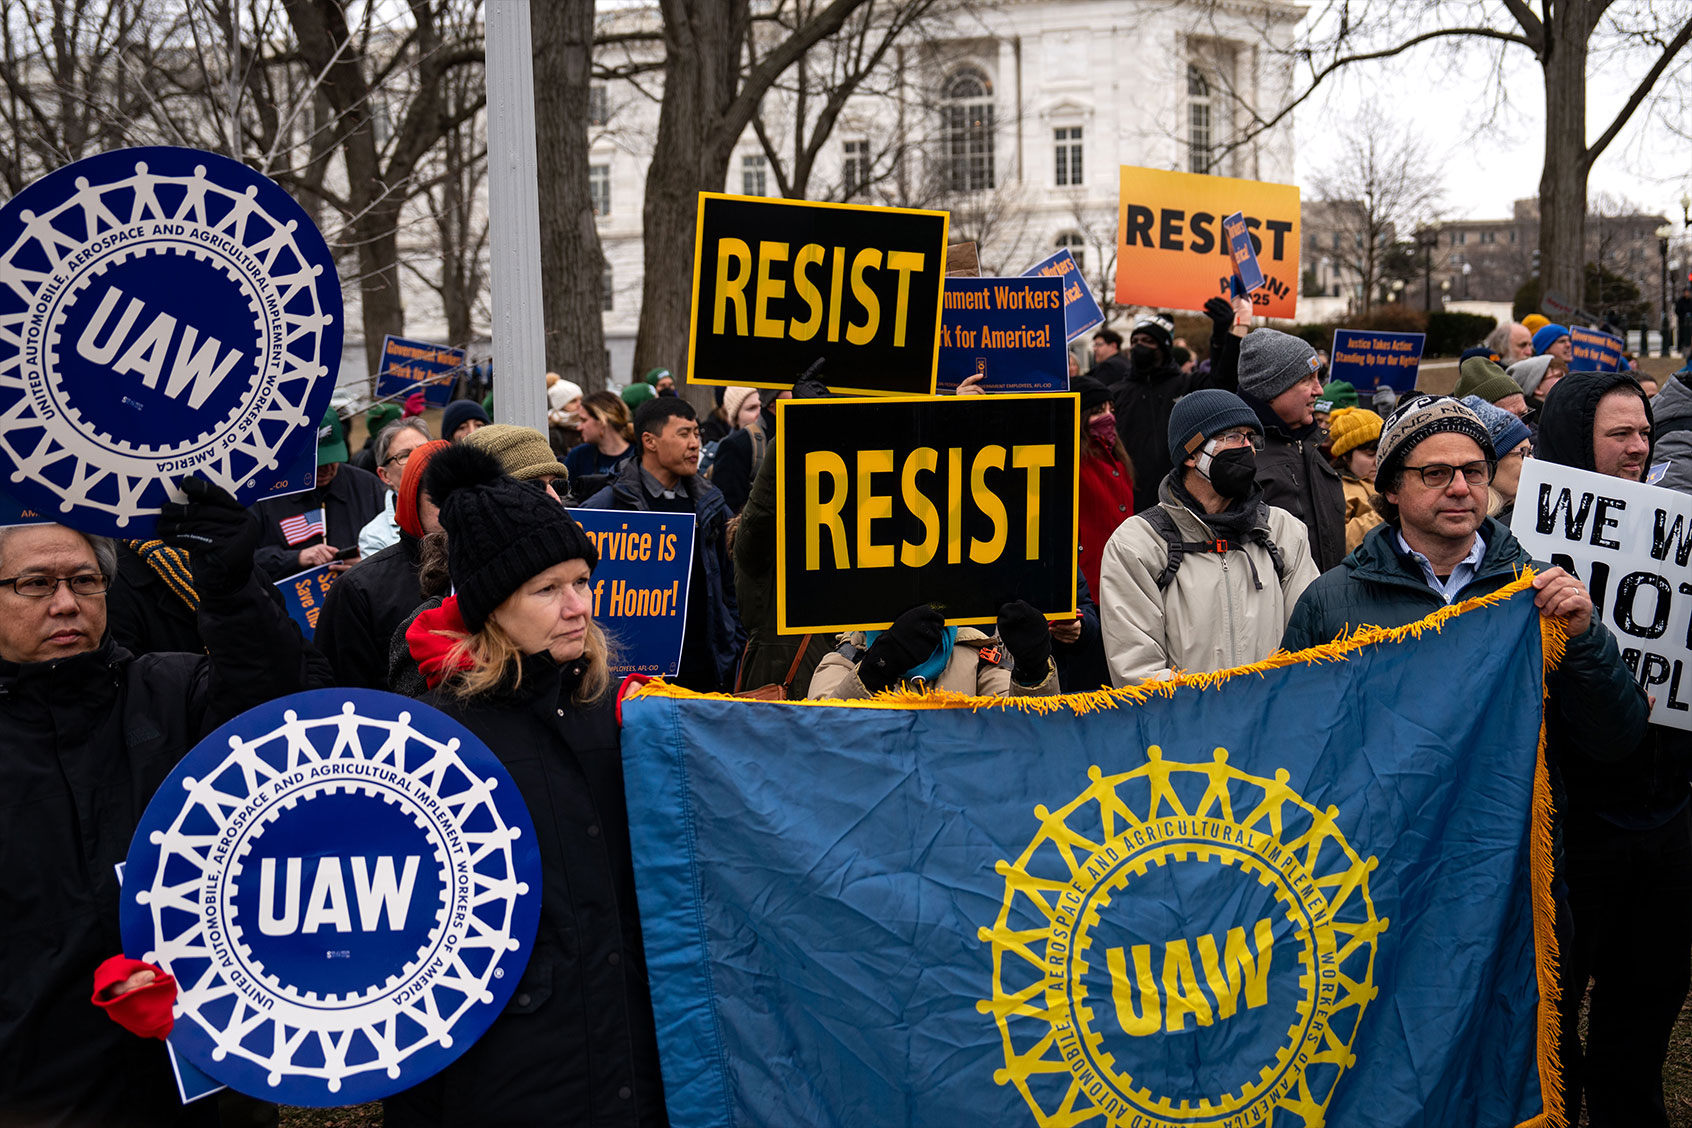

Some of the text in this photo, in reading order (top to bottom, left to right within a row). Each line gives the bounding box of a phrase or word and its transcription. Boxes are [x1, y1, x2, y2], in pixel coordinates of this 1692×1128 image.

[712, 237, 925, 348] RESIST
[943, 285, 1060, 310] nment Workers
[26, 224, 283, 472] UNITED AUTOMOBILE, AEROSPACE AND AGRICULTURAL IMPLEMENT WORKERS OF AMERICA
[76, 285, 245, 410] UAW
[955, 325, 977, 348] for
[981, 324, 1051, 349] America!
[657, 525, 677, 562] is
[804, 443, 1056, 571] RESIST
[1535, 482, 1627, 550] WE
[295, 578, 315, 608] Save
[591, 579, 679, 617] f Honor!
[1087, 847, 1119, 881] AND
[1123, 820, 1255, 851] AGRICULTURAL
[205, 763, 469, 1010] UNITED AUTOMOBILE, AEROSPACE AND AGRICULTURAL IMPLEMENT WORKERS OF AMERICA
[258, 855, 421, 936] UAW
[1261, 840, 1329, 928] IMPLEMENT
[1048, 881, 1087, 991] AEROSPACE
[1106, 917, 1275, 1037] UAW
[1307, 951, 1336, 1044] WORKERS
[1056, 1013, 1129, 1119] AUTOMOBILE,
[1293, 1052, 1308, 1076] OF
